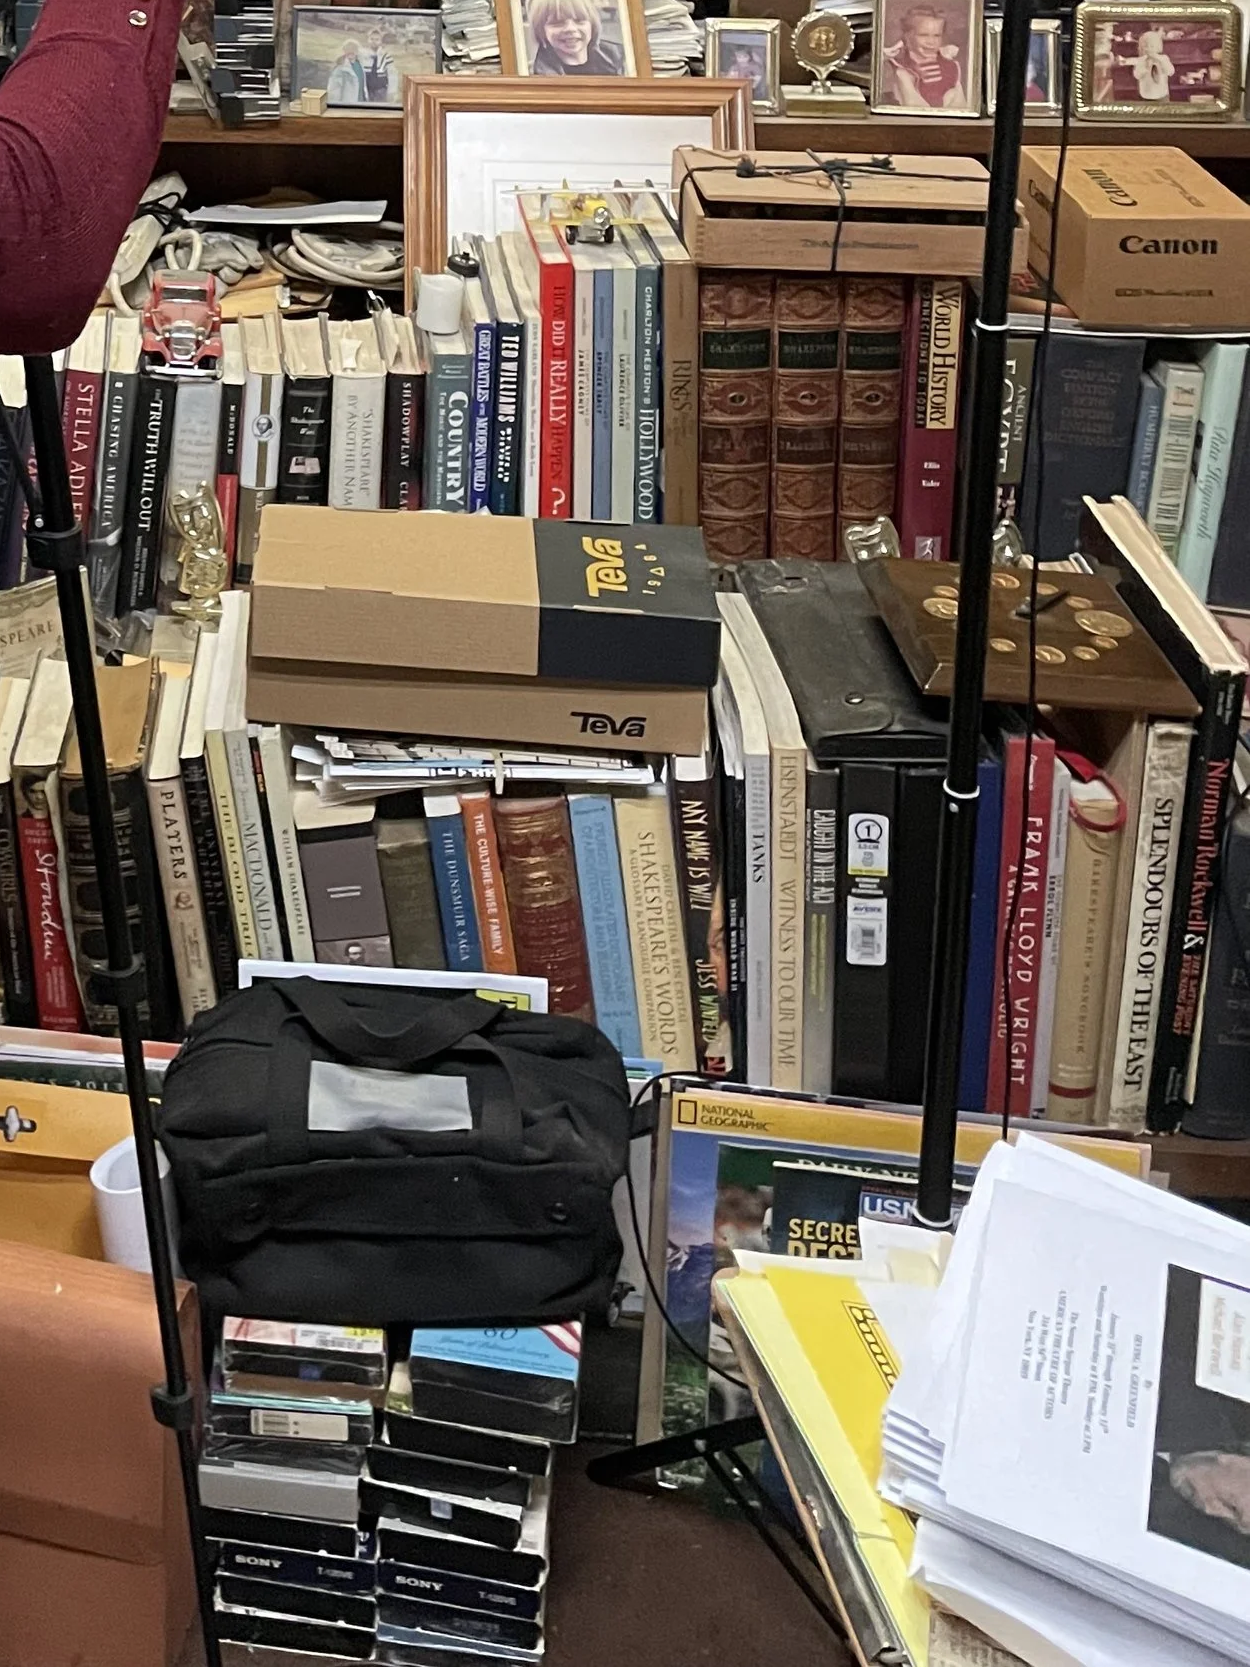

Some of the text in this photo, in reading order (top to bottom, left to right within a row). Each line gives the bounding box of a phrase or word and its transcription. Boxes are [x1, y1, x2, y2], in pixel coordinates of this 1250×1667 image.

[1119, 235, 1218, 255] Canon
[551, 320, 566, 345] DID
[552, 345, 565, 359] IT
[930, 286, 960, 426] WORLD HISTORY
[473, 330, 492, 492] GREAT BATTLES MODERN WORLD
[498, 335, 520, 423] TED WILLIAMS
[549, 359, 567, 425] REALLY
[638, 286, 655, 519] CHARLTON HESTON'S HOLLYWOOD
[1012, 384, 1027, 442] ANCIENT
[71, 383, 94, 452] STELLA
[345, 395, 358, 470] BY ANOTHER
[400, 382, 411, 467] SHADOWPLAY
[445, 391, 468, 505] COUNTRY
[1163, 414, 1193, 465] TIME-LIFE
[102, 395, 123, 528] CHASING AMERICA
[138, 400, 162, 532] TRUTH WILL OUT
[549, 425, 566, 484] HAPPEN
[1157, 467, 1185, 499] BOOKS
[1195, 426, 1228, 540] Rita Hayworth
[582, 536, 628, 598] Teva
[570, 711, 647, 738] Teva
[159, 791, 188, 880] PLAYERS
[220, 793, 244, 904] THE BLOOD
[680, 800, 712, 912] MY NAME IS WILL
[751, 833, 765, 883] TANKS
[814, 809, 836, 850] CAUGHT
[815, 851, 835, 863] IN
[1183, 758, 1231, 950] Norman Rockwell &
[243, 822, 273, 931] MACDONALD
[281, 829, 305, 936] WILLIAM SHAKESPEARE
[442, 832, 453, 852] THE
[458, 930, 470, 961] SAGA
[474, 813, 504, 956] THE CULTURE-WISE FAMILY
[630, 857, 643, 909] GLOSSARY
[815, 865, 835, 884] THE
[815, 886, 835, 904] ACT
[637, 831, 678, 1055] SHAKESPEARE'S WORDS
[662, 864, 673, 899] DAVID
[672, 958, 682, 980] BEN
[777, 755, 797, 1067] EISENSTAEDT WITNESS TO OUR TIME
[1123, 796, 1173, 1092] SPLENDOURS OF THE EAST
[637, 921, 649, 974] LANGUAGE
[730, 963, 738, 982] WAR
[1010, 816, 1043, 1086] FRANK LLOYD WRIGHT
[642, 977, 657, 1042] COMPANION
[693, 958, 719, 1042] JESS WINFIELD
[700, 1115, 770, 1132] GEOGRAPHIC
[701, 1103, 756, 1120] NATIONAL
[235, 1553, 283, 1570] SONY
[395, 1575, 443, 1593] SONY
